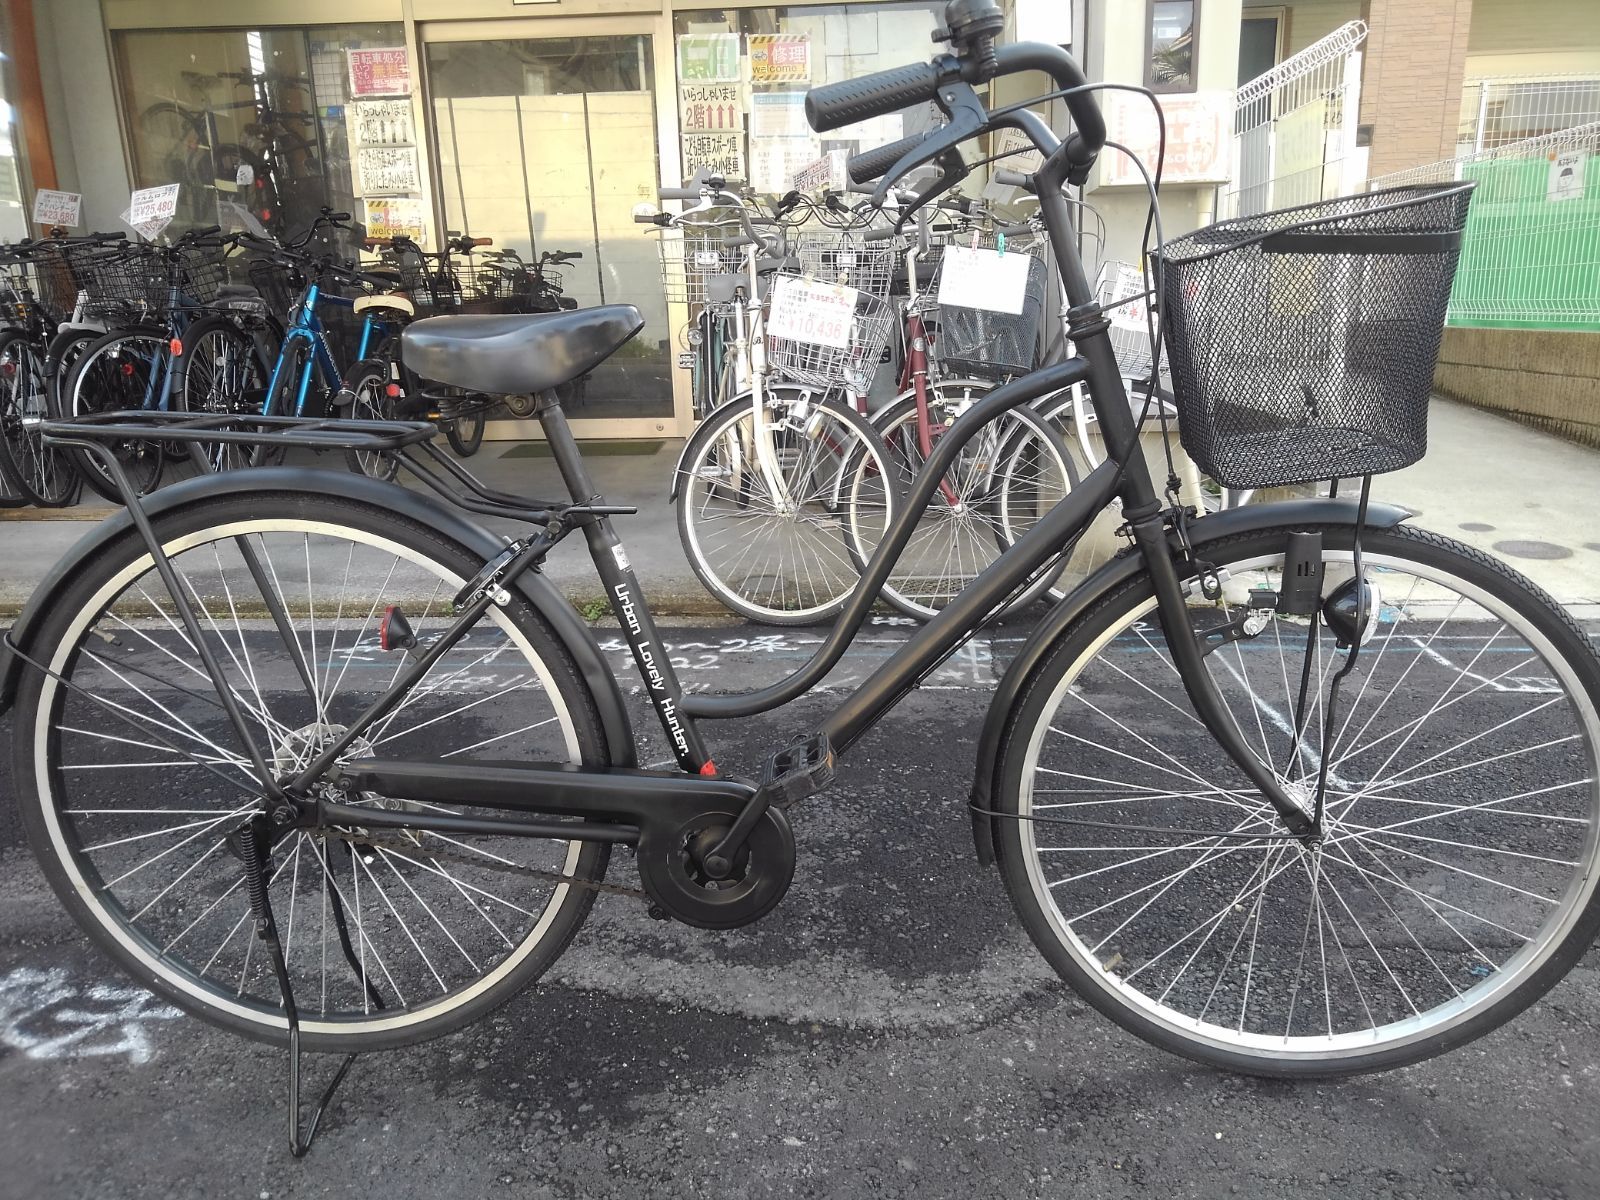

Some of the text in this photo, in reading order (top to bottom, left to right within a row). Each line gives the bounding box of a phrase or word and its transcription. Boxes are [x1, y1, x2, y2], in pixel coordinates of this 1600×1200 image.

[352, 52, 405, 65] 自転車処分
[771, 46, 805, 63] 修理
[752, 65, 797, 73] welcome
[683, 86, 736, 102] いらっしゃいませ
[686, 104, 705, 129] 2階
[140, 200, 173, 216] ¥25,480
[788, 318, 842, 339] ¥10,436
[614, 582, 642, 636] Urban
[637, 640, 666, 691] Lovely
[660, 697, 690, 758] Hunter.
